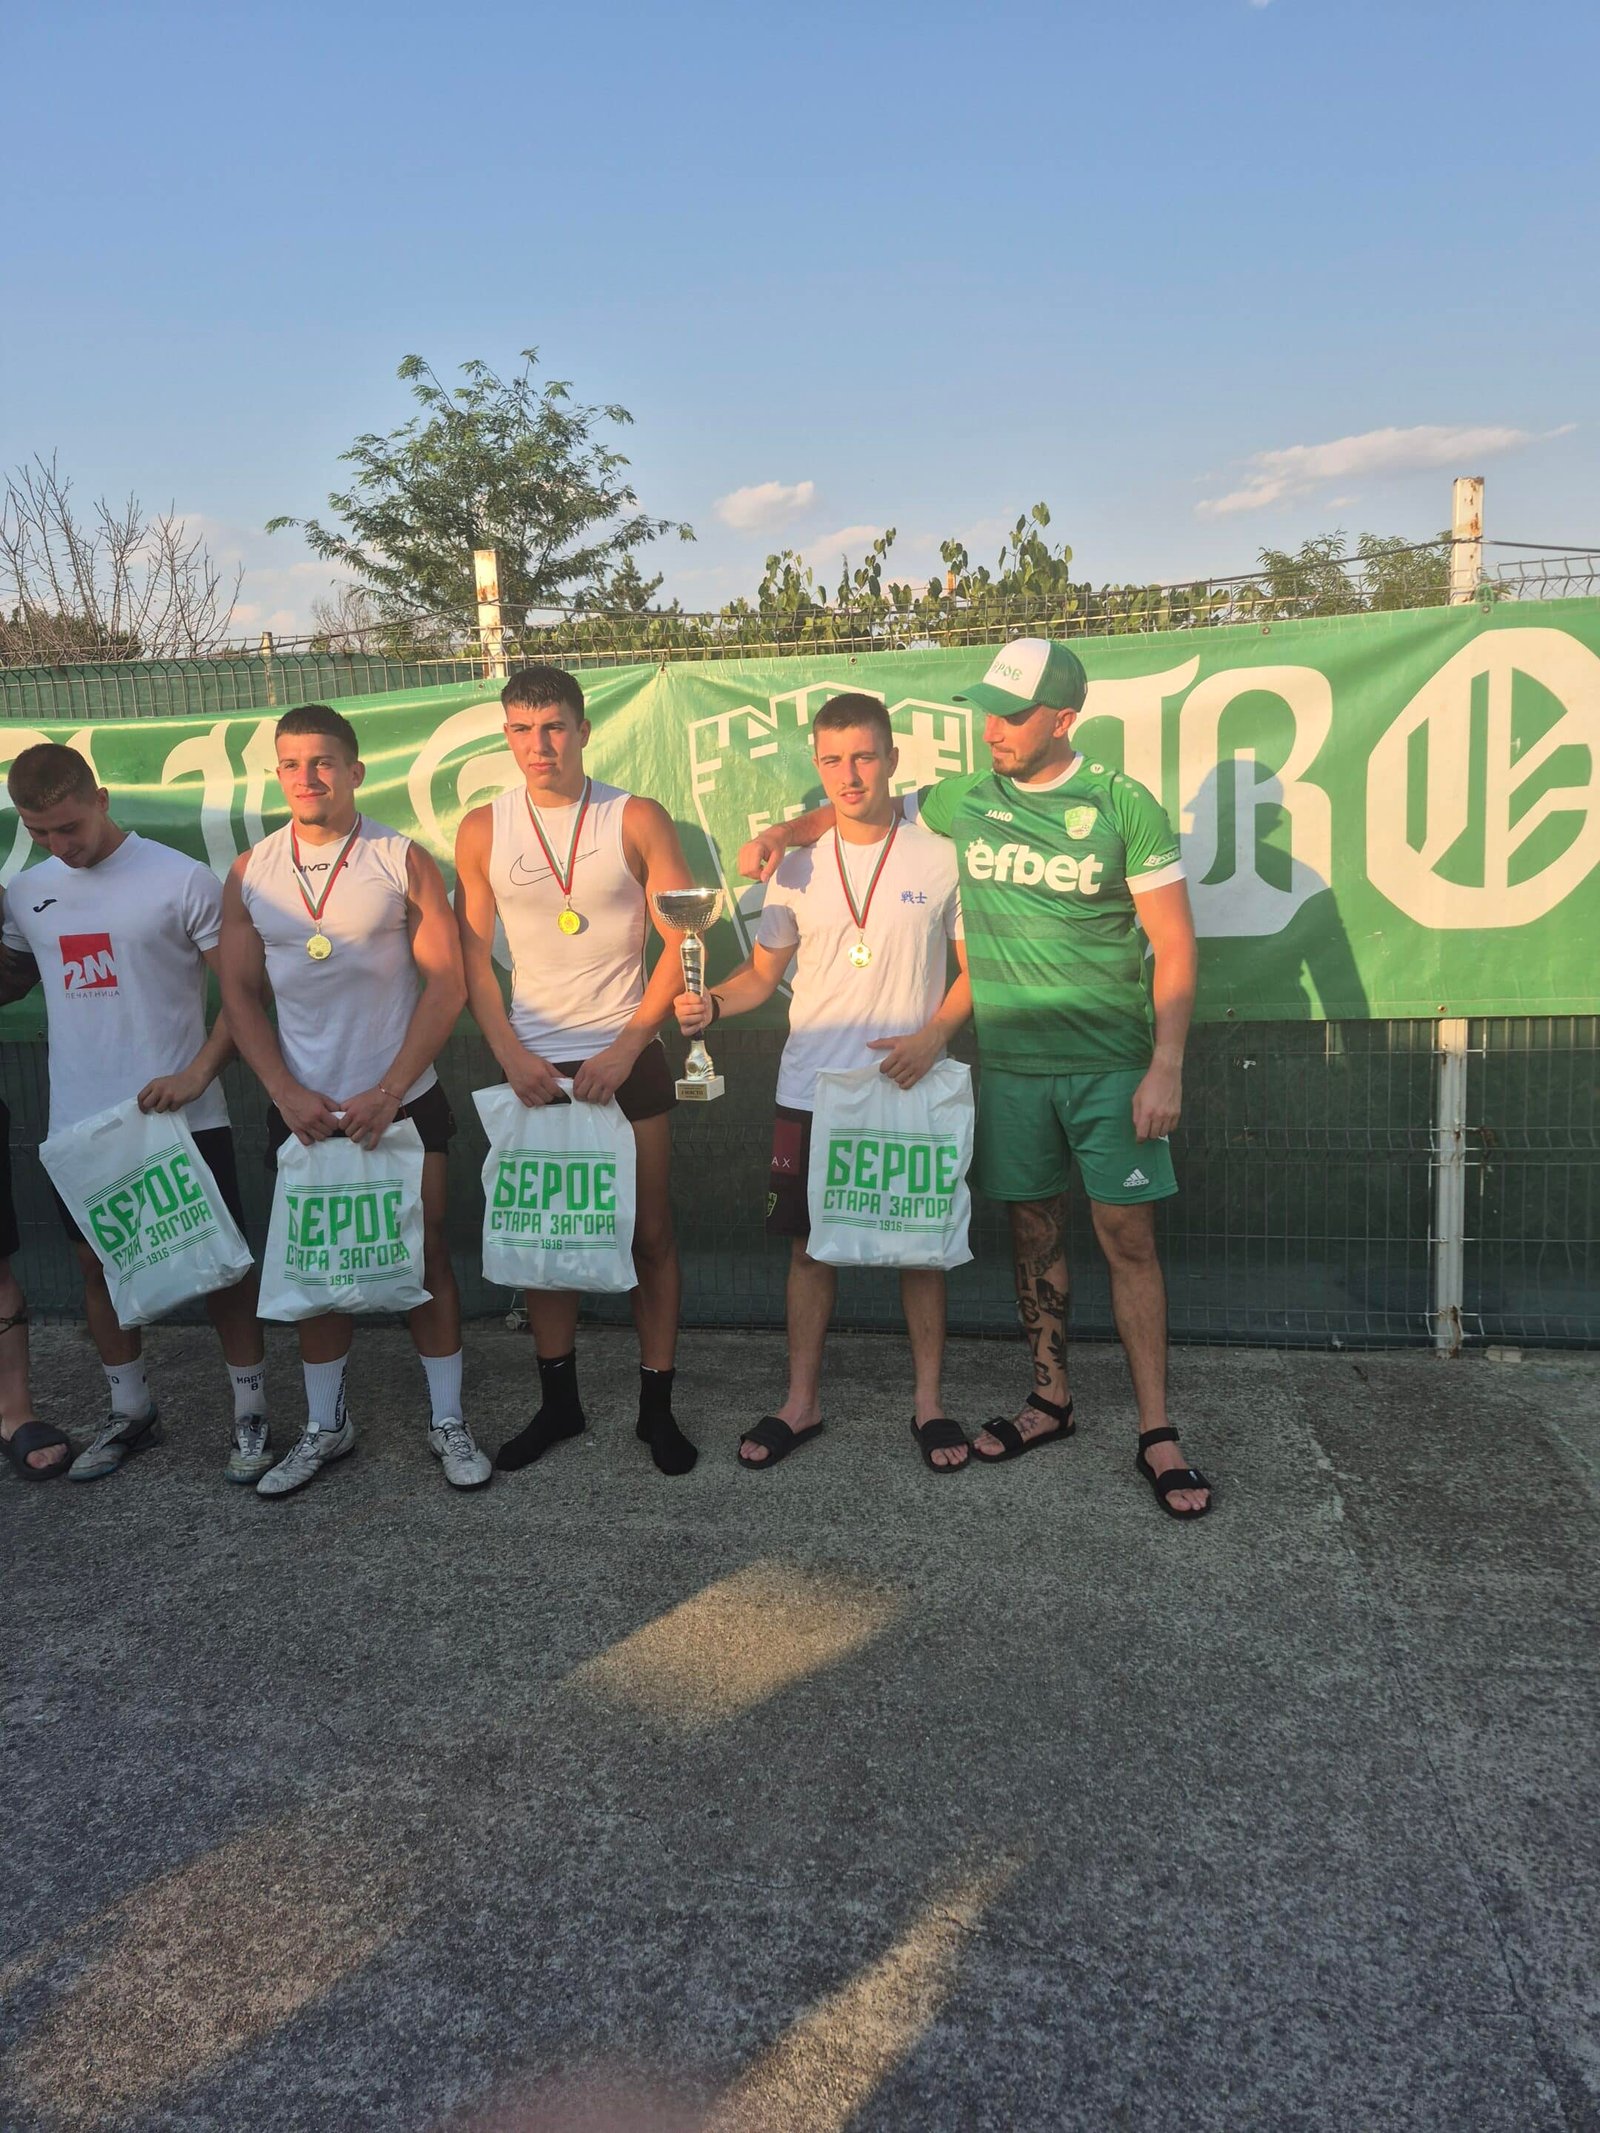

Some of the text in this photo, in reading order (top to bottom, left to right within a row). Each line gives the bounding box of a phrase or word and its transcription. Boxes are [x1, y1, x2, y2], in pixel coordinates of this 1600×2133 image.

[985, 809, 1014, 822] JAKO
[967, 843, 1104, 895] efbet
[64, 949, 117, 990] 2M
[65, 990, 121, 999] ПЕЧАТНИЦА
[826, 1140, 958, 1194] БЕРОЕ
[493, 1161, 616, 1210] БЕРОЕ
[1123, 1179, 1149, 1187] adidas
[824, 1190, 881, 1215] СТАРА
[145, 1201, 213, 1248] ЗАГОРА
[491, 1211, 616, 1235] СТАРА ЗАГОРА
[879, 1220, 903, 1232] 1916
[146, 1247, 170, 1265] 1916
[339, 1241, 410, 1270] ЗАГОРА
[541, 1239, 562, 1250] 1916
[329, 1274, 354, 1286] 1916
